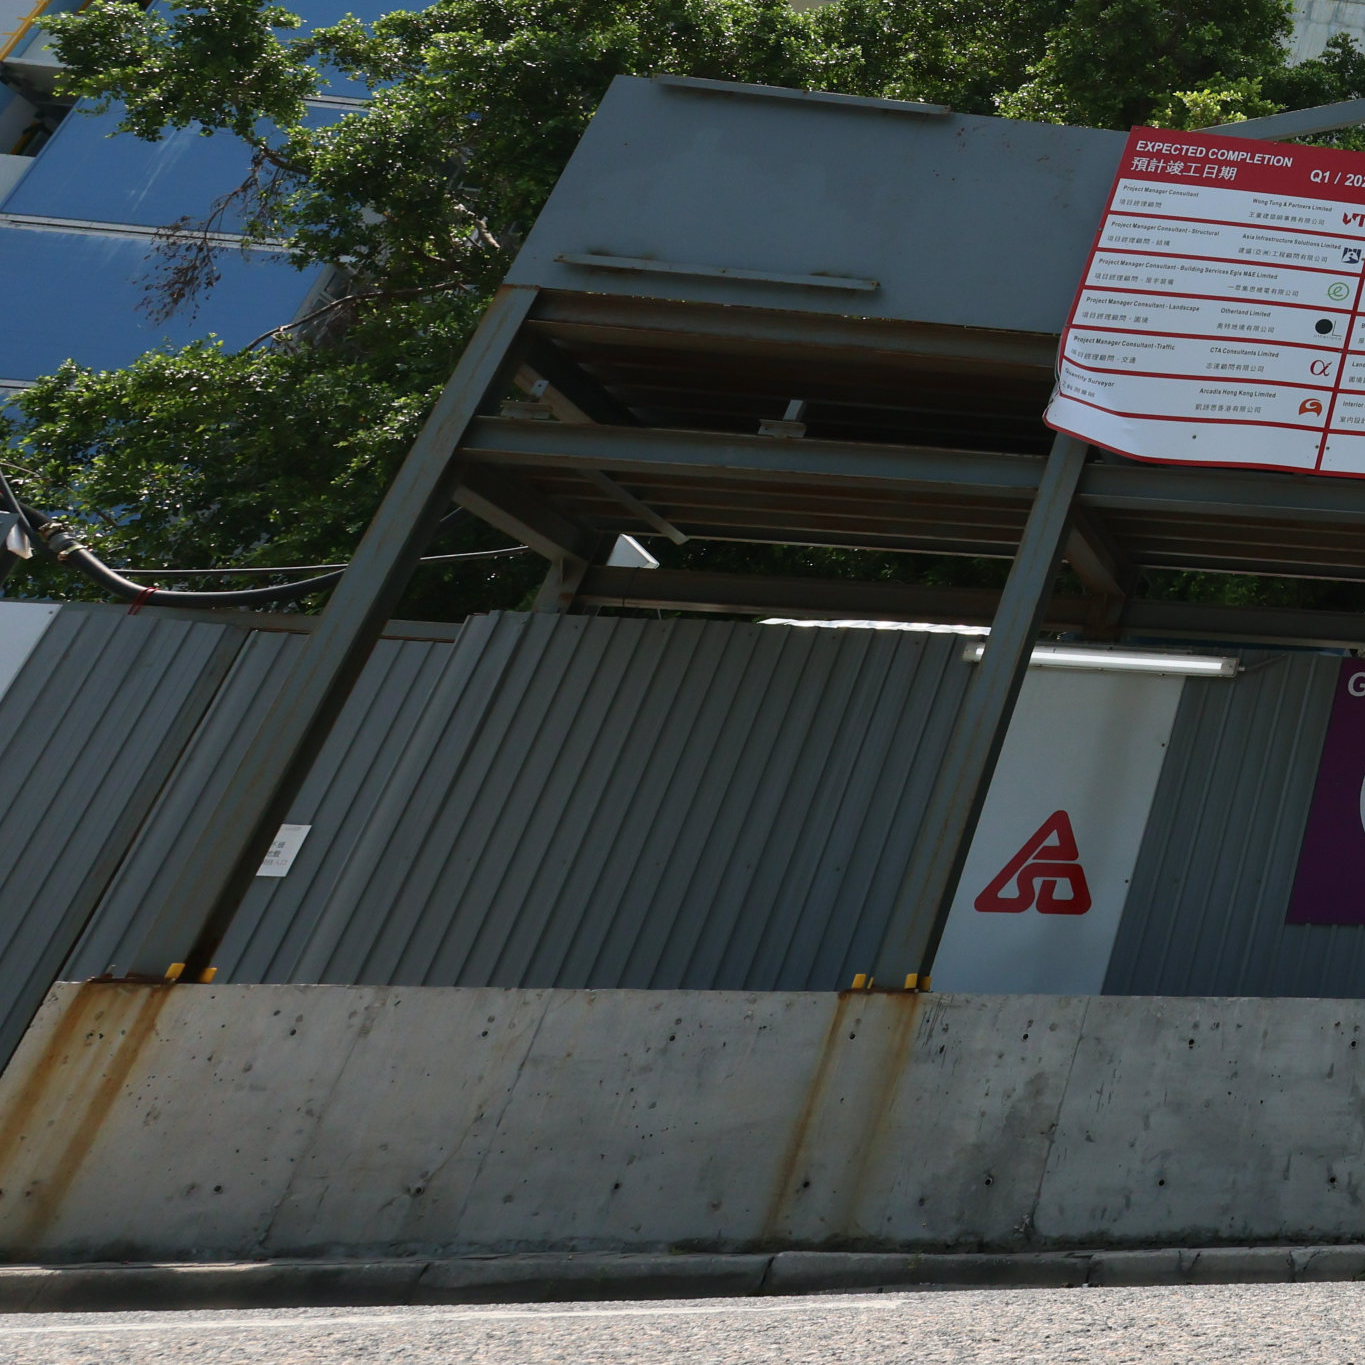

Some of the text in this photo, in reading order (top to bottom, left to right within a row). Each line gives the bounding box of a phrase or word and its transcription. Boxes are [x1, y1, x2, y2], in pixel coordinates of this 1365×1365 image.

[1136, 141, 1293, 167] EXPECTED COMPLETION
[1131, 156, 1237, 181] 預計竣工日期
[1310, 169, 1330, 184] Q1
[1123, 185, 1144, 193] Project
[1144, 187, 1168, 195] Manager
[1252, 198, 1269, 206] Wong
[1288, 202, 1311, 210] Partners
[1111, 221, 1220, 236] Project Manager Consultant Structural
[1255, 235, 1293, 244] Infrastructure
[1294, 239, 1320, 247] Solutions
[1320, 242, 1342, 250] Limited
[1098, 258, 1229, 275] Project Manager Consultant Building Services
[1256, 272, 1278, 280] Limited
[1086, 296, 1200, 312] Project Manager Consultant Landscape
[1220, 307, 1271, 318] Otherland Limited
[1073, 335, 1154, 349] Project Manager Consultant
[1222, 347, 1257, 357] Consultants
[1257, 350, 1280, 358] Limited
[1065, 367, 1115, 388] Quantity Surveyor
[1222, 389, 1237, 397] Hong
[1238, 390, 1254, 398] Kong
[1254, 391, 1277, 399] Limited
[1342, 400, 1364, 408] Interior
